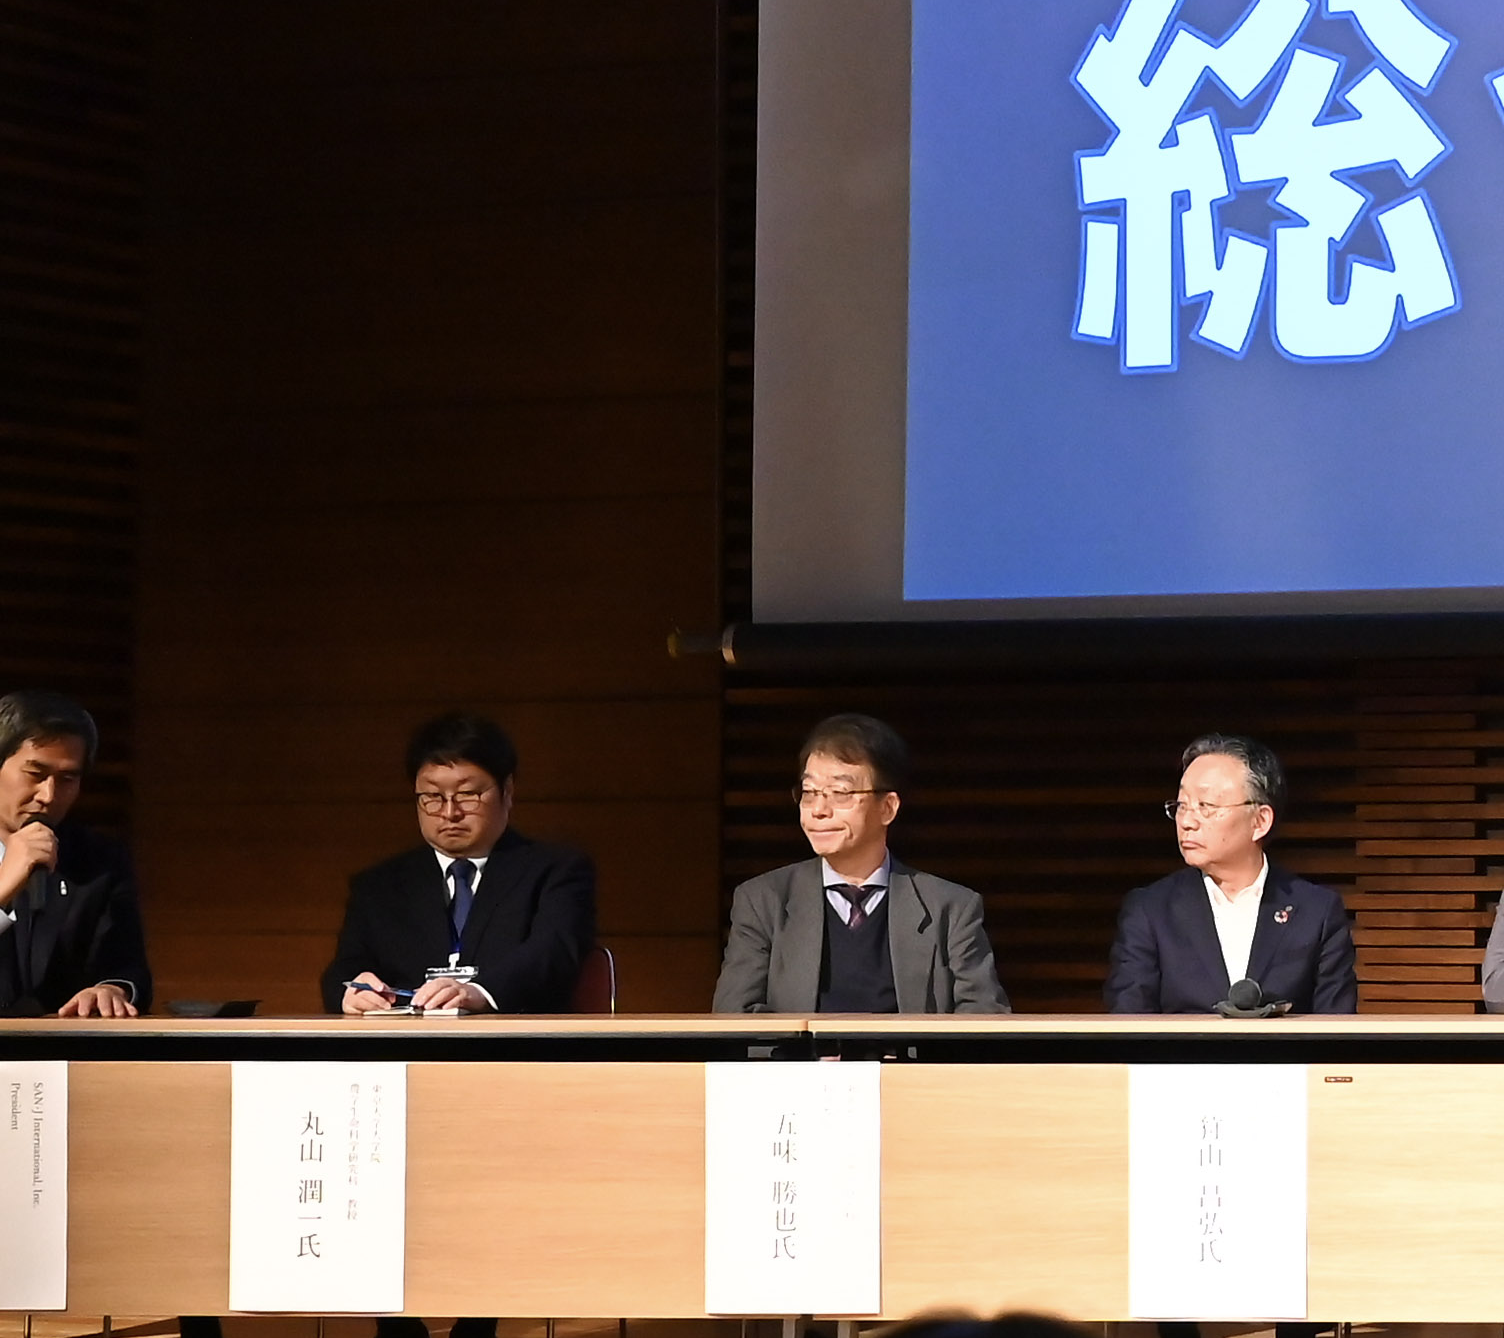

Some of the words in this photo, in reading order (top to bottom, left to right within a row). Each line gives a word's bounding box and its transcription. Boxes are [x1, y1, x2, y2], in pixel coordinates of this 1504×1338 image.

[10, 1081, 22, 1130] President
[300, 1110, 325, 1163] 丸山
[296, 1178, 324, 1259] 潤一氏
